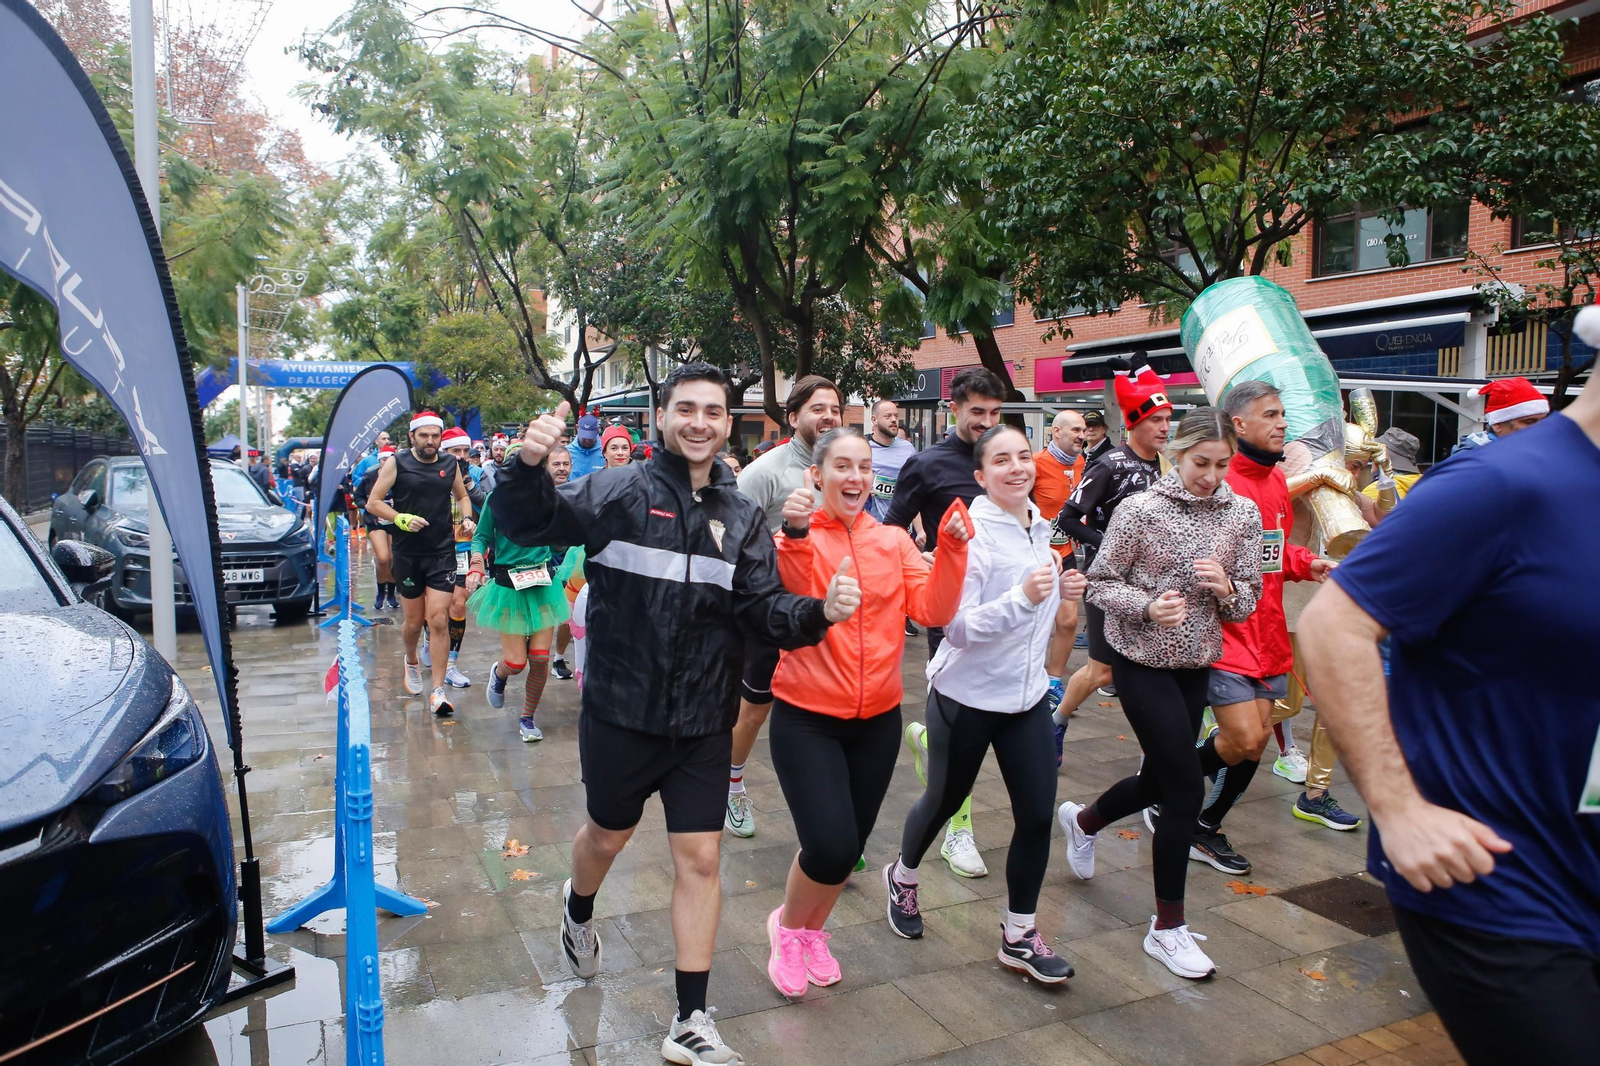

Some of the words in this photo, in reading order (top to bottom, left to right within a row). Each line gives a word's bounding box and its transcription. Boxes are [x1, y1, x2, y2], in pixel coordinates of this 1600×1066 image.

[281, 363, 370, 374] AYUNTAMIEN
[288, 376, 303, 384] DE
[306, 375, 351, 385] ALGECI
[349, 397, 401, 449] CUPRA
[355, 405, 406, 454] TURIAL
[1262, 545, 1280, 562] 59
[225, 572, 238, 581] 48
[241, 571, 260, 580] MWG
[515, 570, 546, 583] 230
